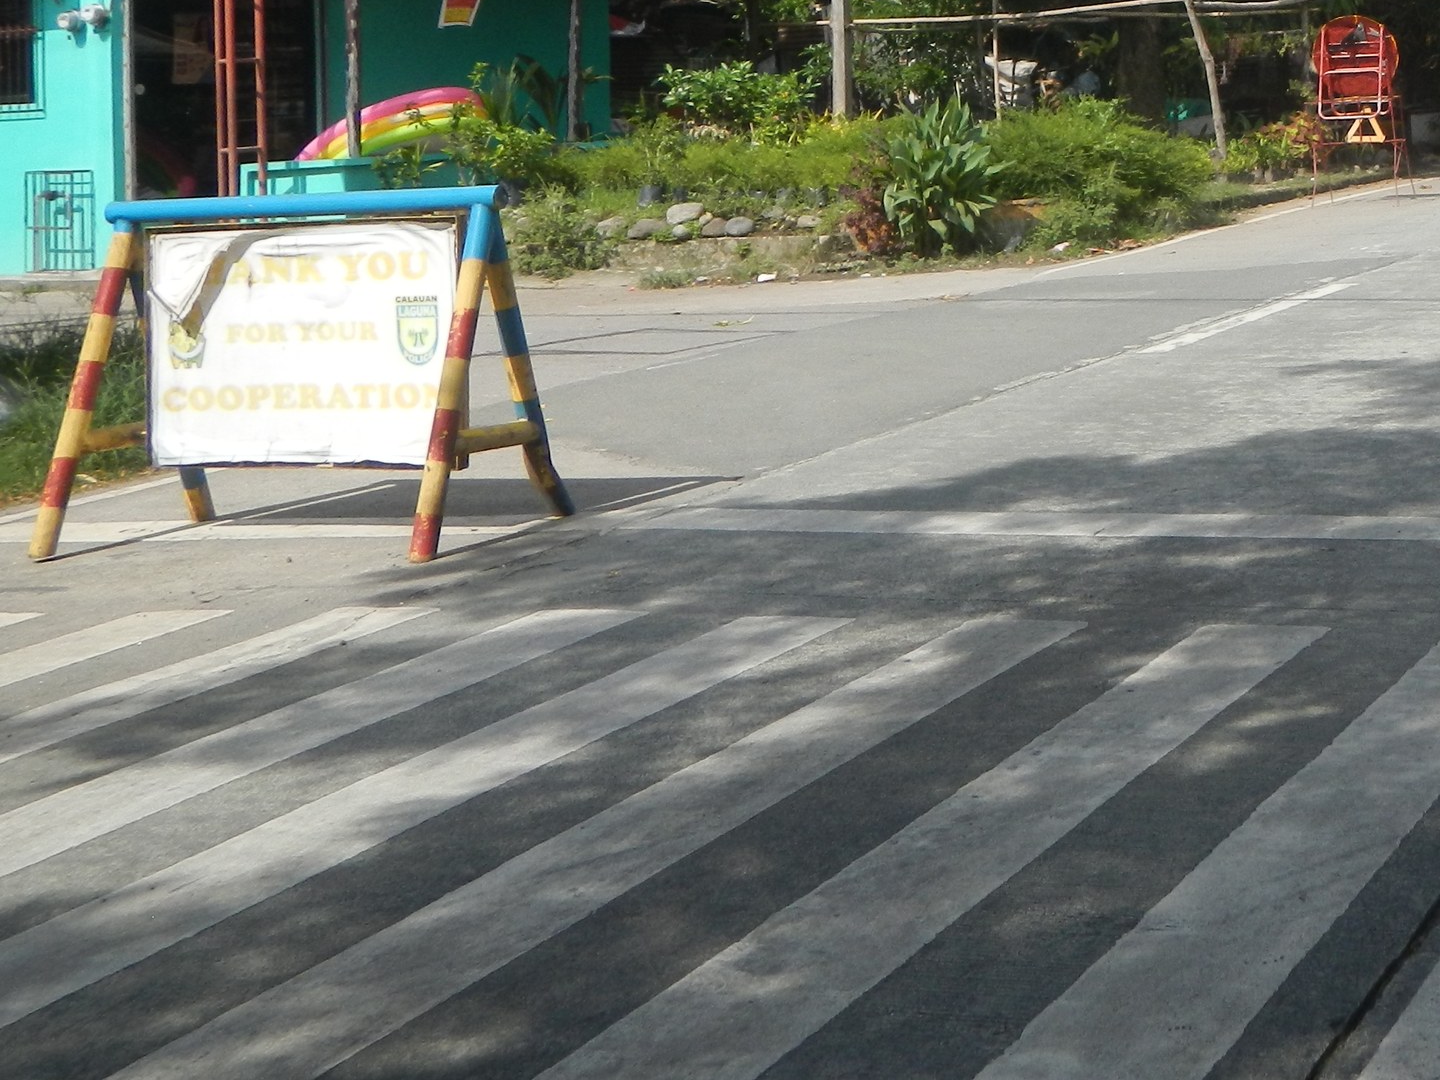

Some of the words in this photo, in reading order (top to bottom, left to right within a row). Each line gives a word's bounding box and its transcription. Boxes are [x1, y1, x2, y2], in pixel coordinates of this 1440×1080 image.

[222, 255, 325, 285] ANK
[338, 251, 430, 282] YOU
[395, 295, 438, 303] CALAUAN
[399, 305, 437, 318] LAGUNA
[226, 322, 288, 343] FOR
[292, 320, 378, 342] YOUR
